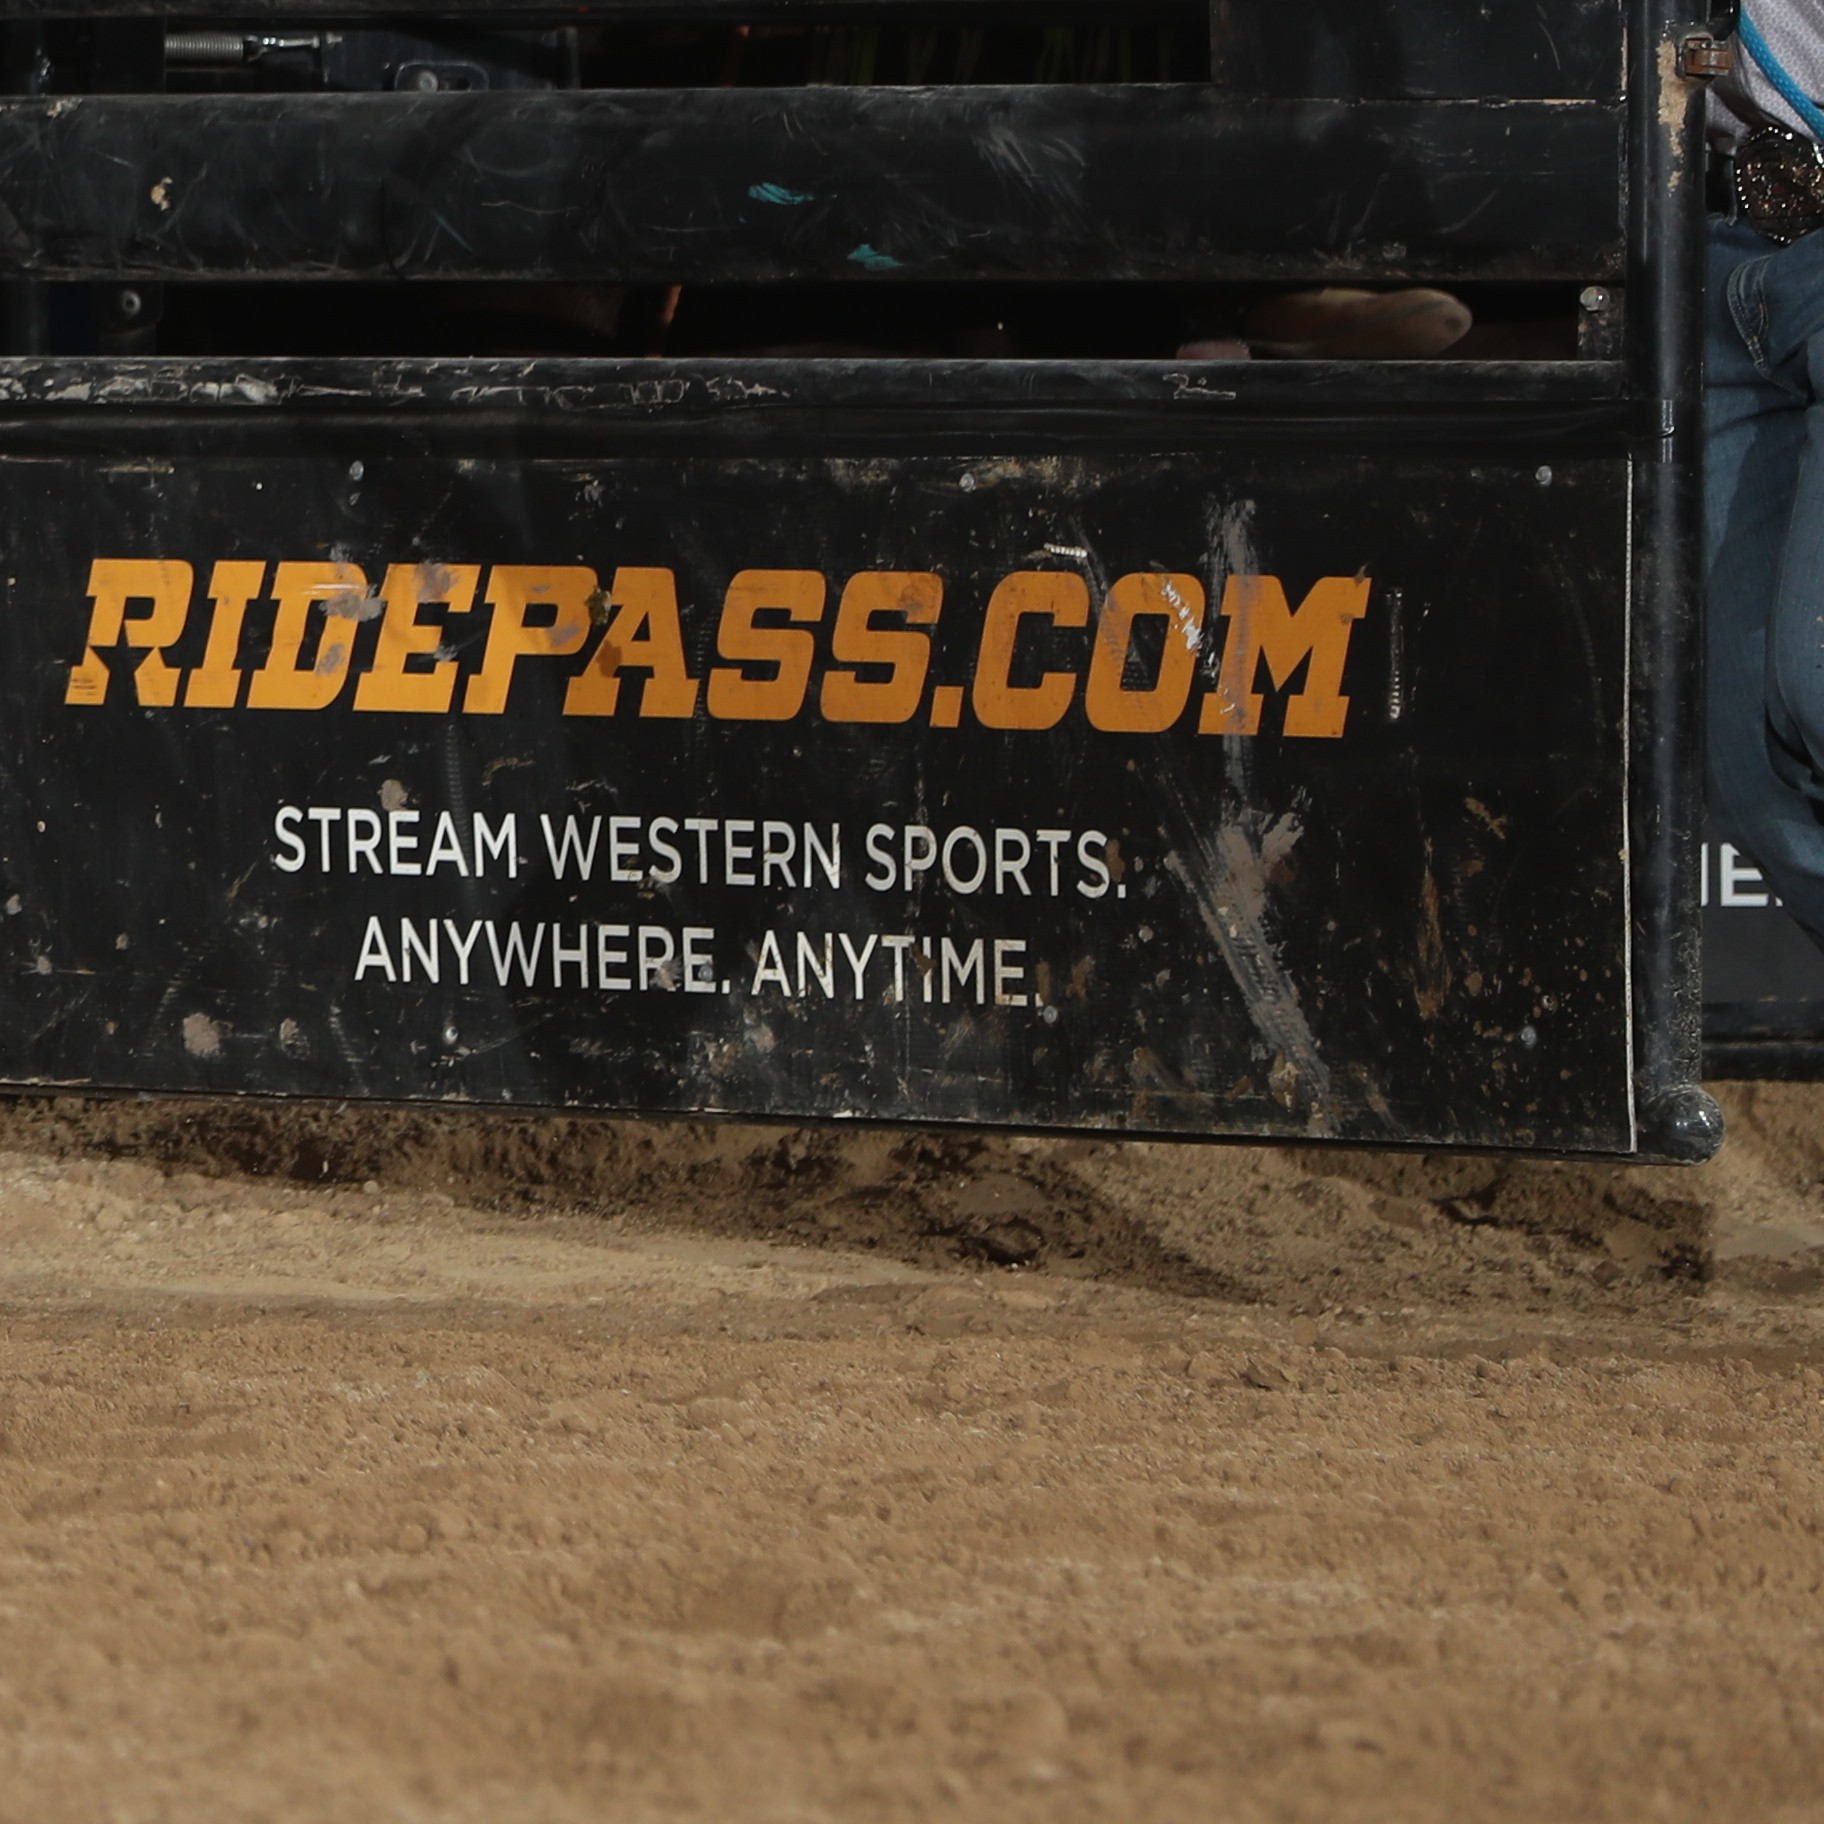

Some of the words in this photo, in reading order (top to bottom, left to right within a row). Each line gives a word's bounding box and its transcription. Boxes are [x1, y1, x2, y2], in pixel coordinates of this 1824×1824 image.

[63, 558, 1371, 739] RIDEPASS.COM
[273, 805, 519, 879] STREAM
[541, 813, 842, 889] WESTERN
[864, 823, 1128, 899] SPORTS.
[354, 916, 731, 996] ANYWHERE.
[751, 929, 1045, 1008] ANYTIME.
